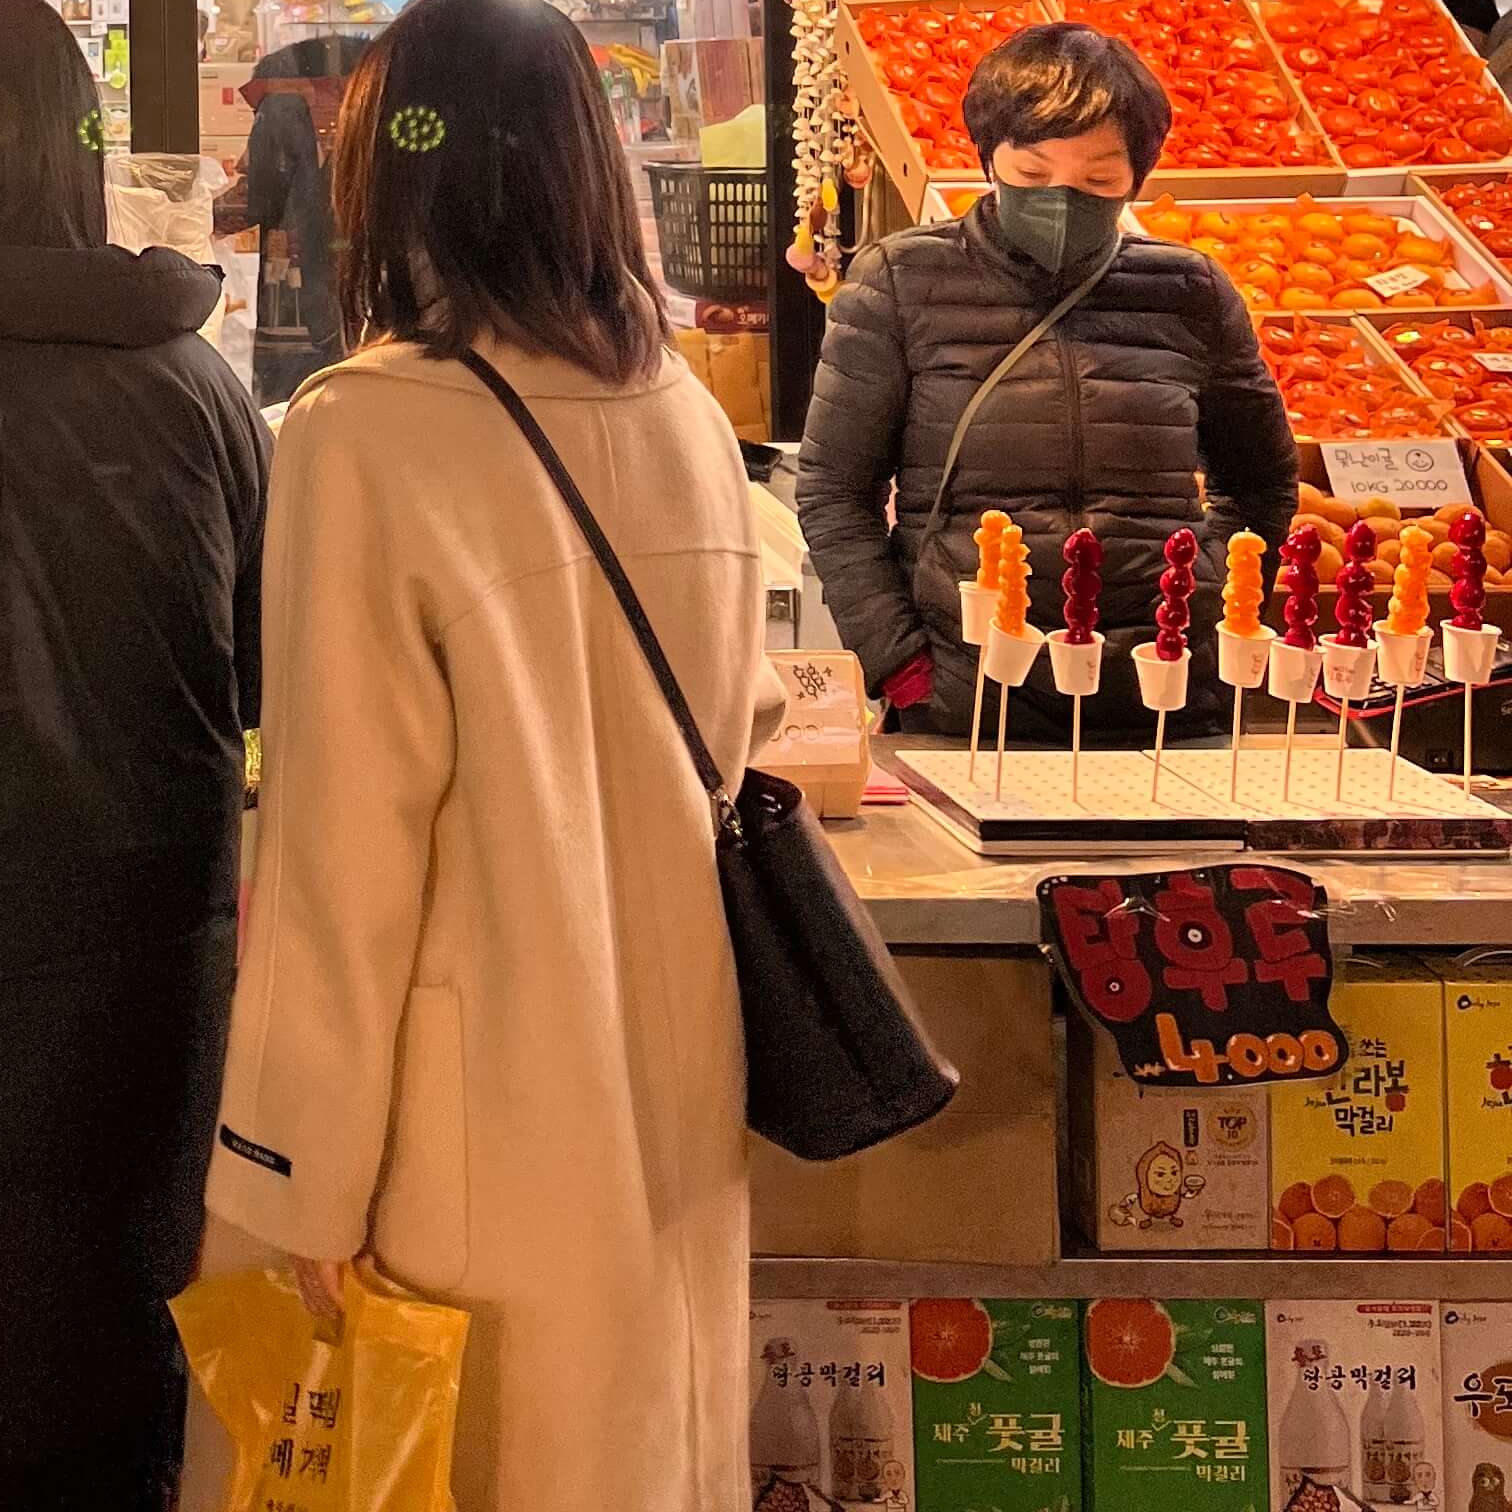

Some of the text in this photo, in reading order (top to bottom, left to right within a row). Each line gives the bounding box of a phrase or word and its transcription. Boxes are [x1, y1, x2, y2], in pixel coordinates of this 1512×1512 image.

[1351, 480, 1388, 494] 10KG
[1053, 868, 1328, 1023] 탕후루
[1218, 1116, 1247, 1130] TOP
[1335, 1105, 1394, 1137] 막걸리
[933, 1424, 970, 1443] 제주
[1116, 1429, 1155, 1449] 제주
[1196, 1464, 1246, 1482] 막걸리
